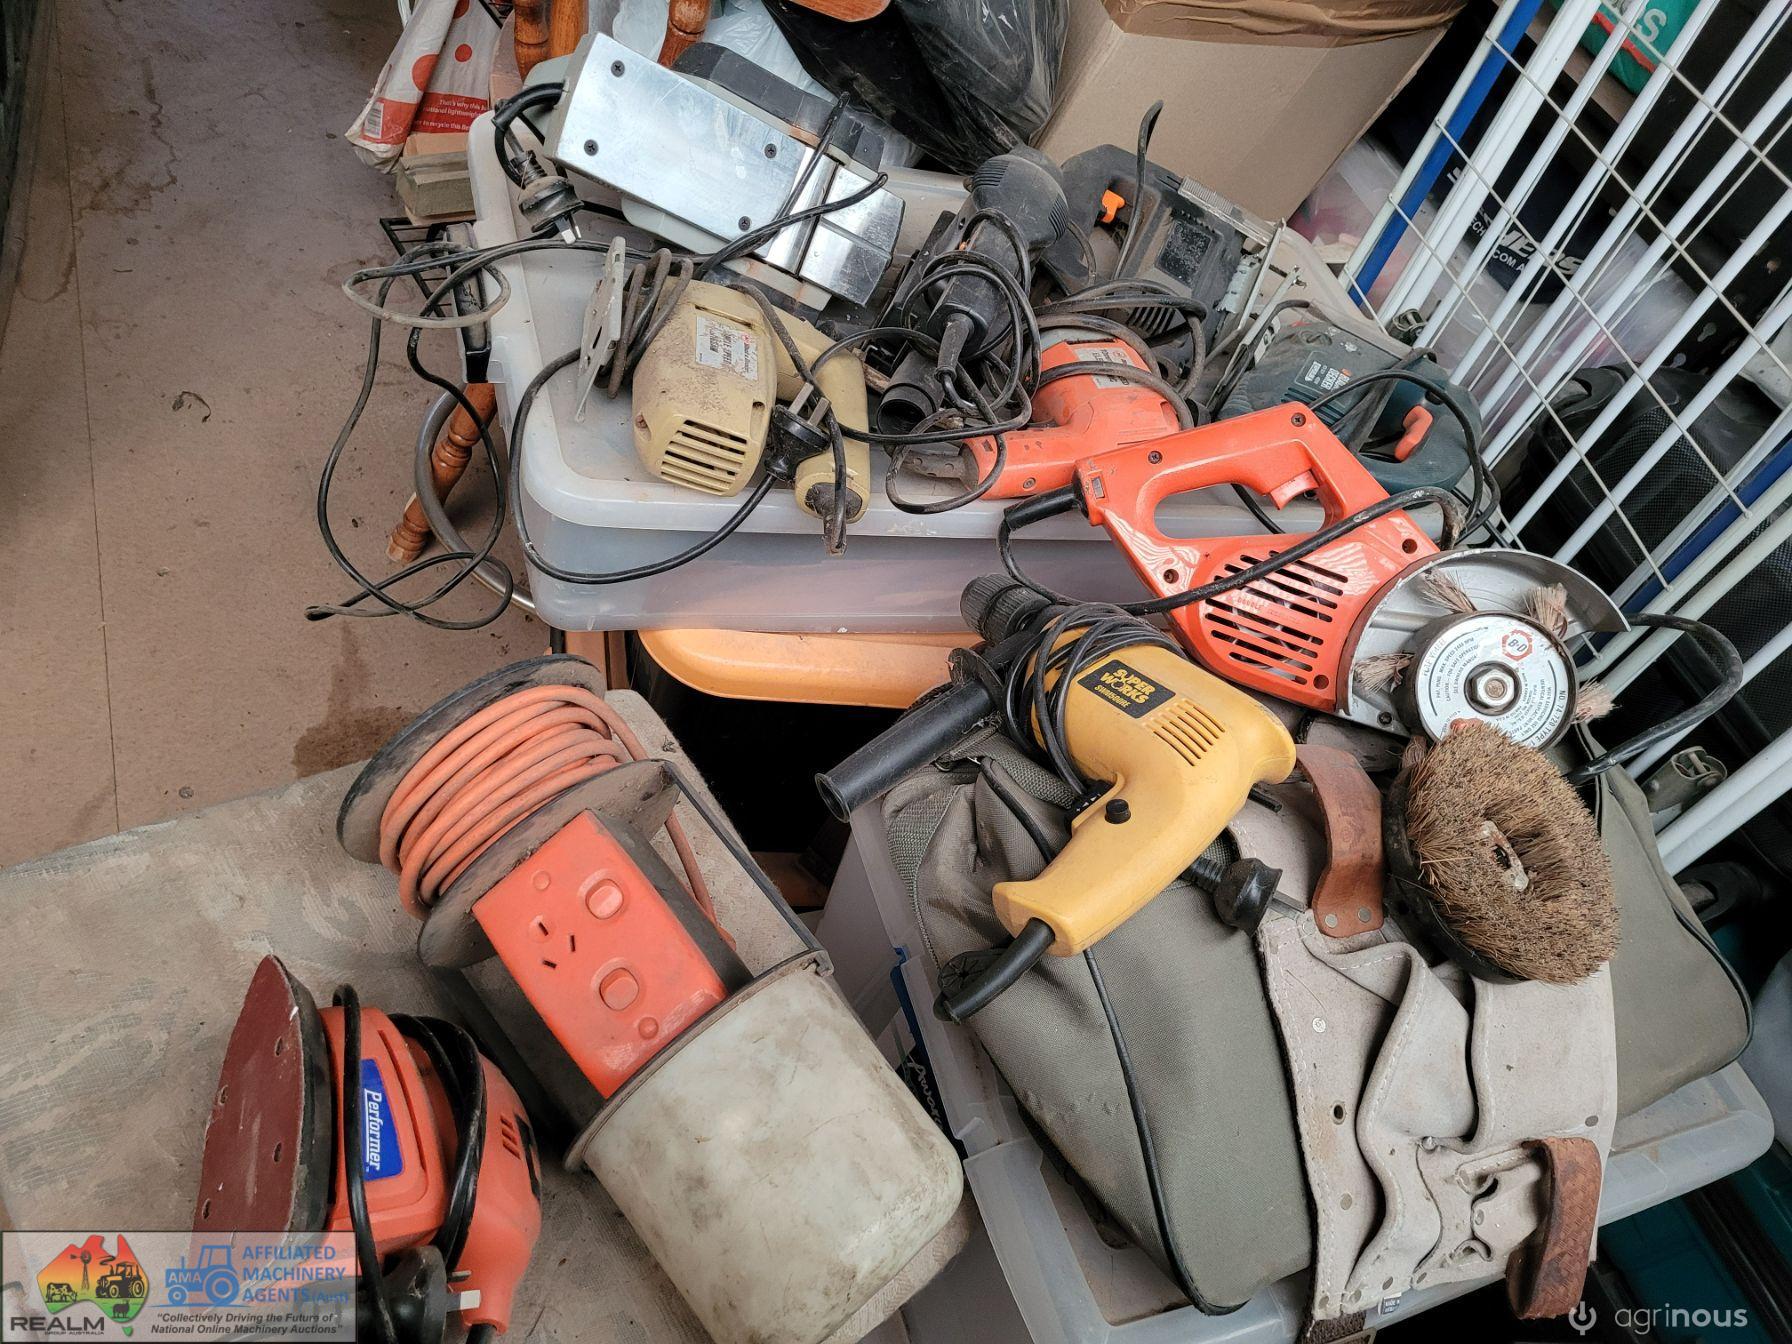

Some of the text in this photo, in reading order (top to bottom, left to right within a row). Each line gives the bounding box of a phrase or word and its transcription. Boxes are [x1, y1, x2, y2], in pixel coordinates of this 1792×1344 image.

[1100, 672, 1149, 704] WORKS
[1113, 668, 1156, 696] SUPER
[1535, 727, 1552, 742] TYPE
[364, 1088, 384, 1172] Performer
